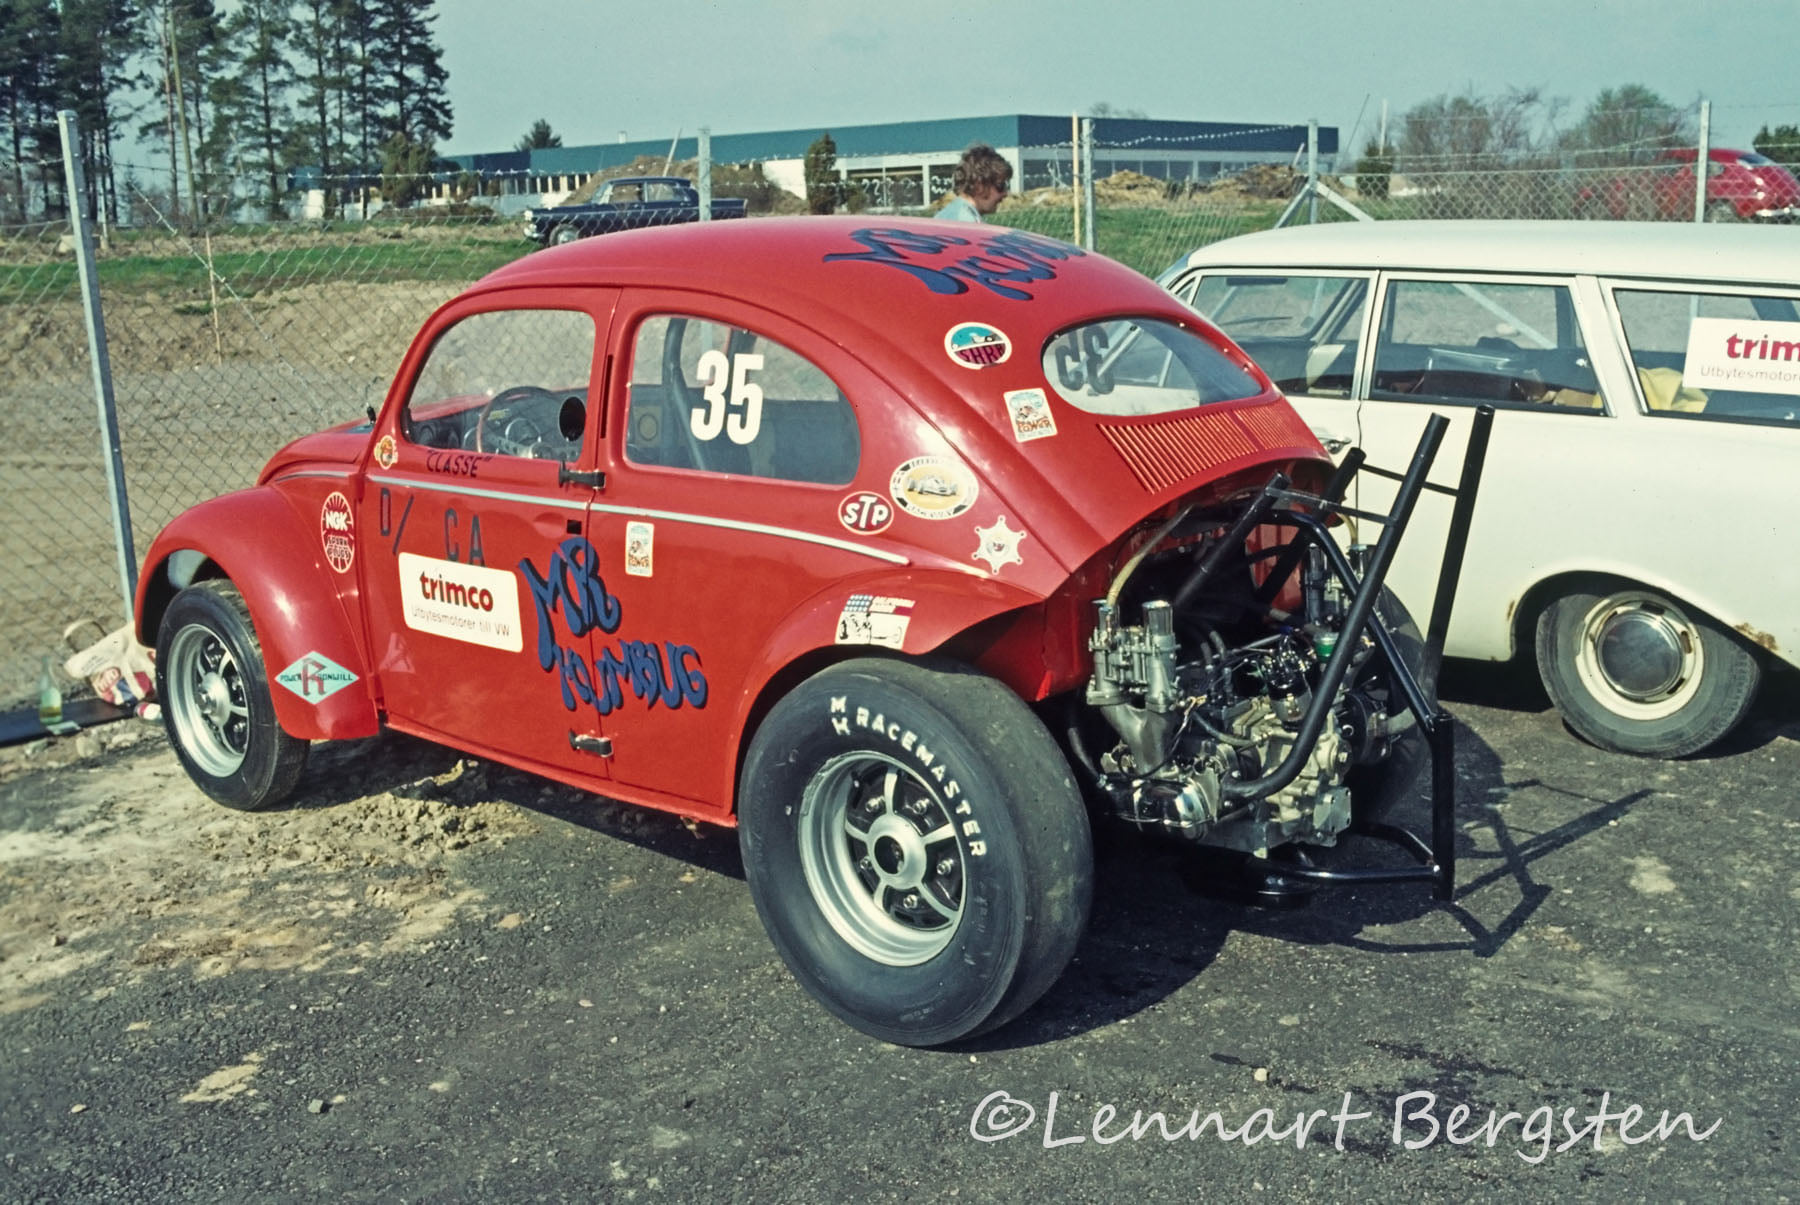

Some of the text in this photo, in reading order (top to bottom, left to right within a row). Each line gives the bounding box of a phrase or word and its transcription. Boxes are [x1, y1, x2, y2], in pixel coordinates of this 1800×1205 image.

[690, 349, 764, 445] 35
[1700, 366, 1800, 382] Utbytesmotor
[325, 510, 348, 532] NGK
[843, 495, 888, 529] STP
[419, 570, 494, 613] trimco
[518, 537, 623, 674] MR
[551, 638, 709, 717] HUMBUG
[855, 706, 988, 857] RACEMASTER
